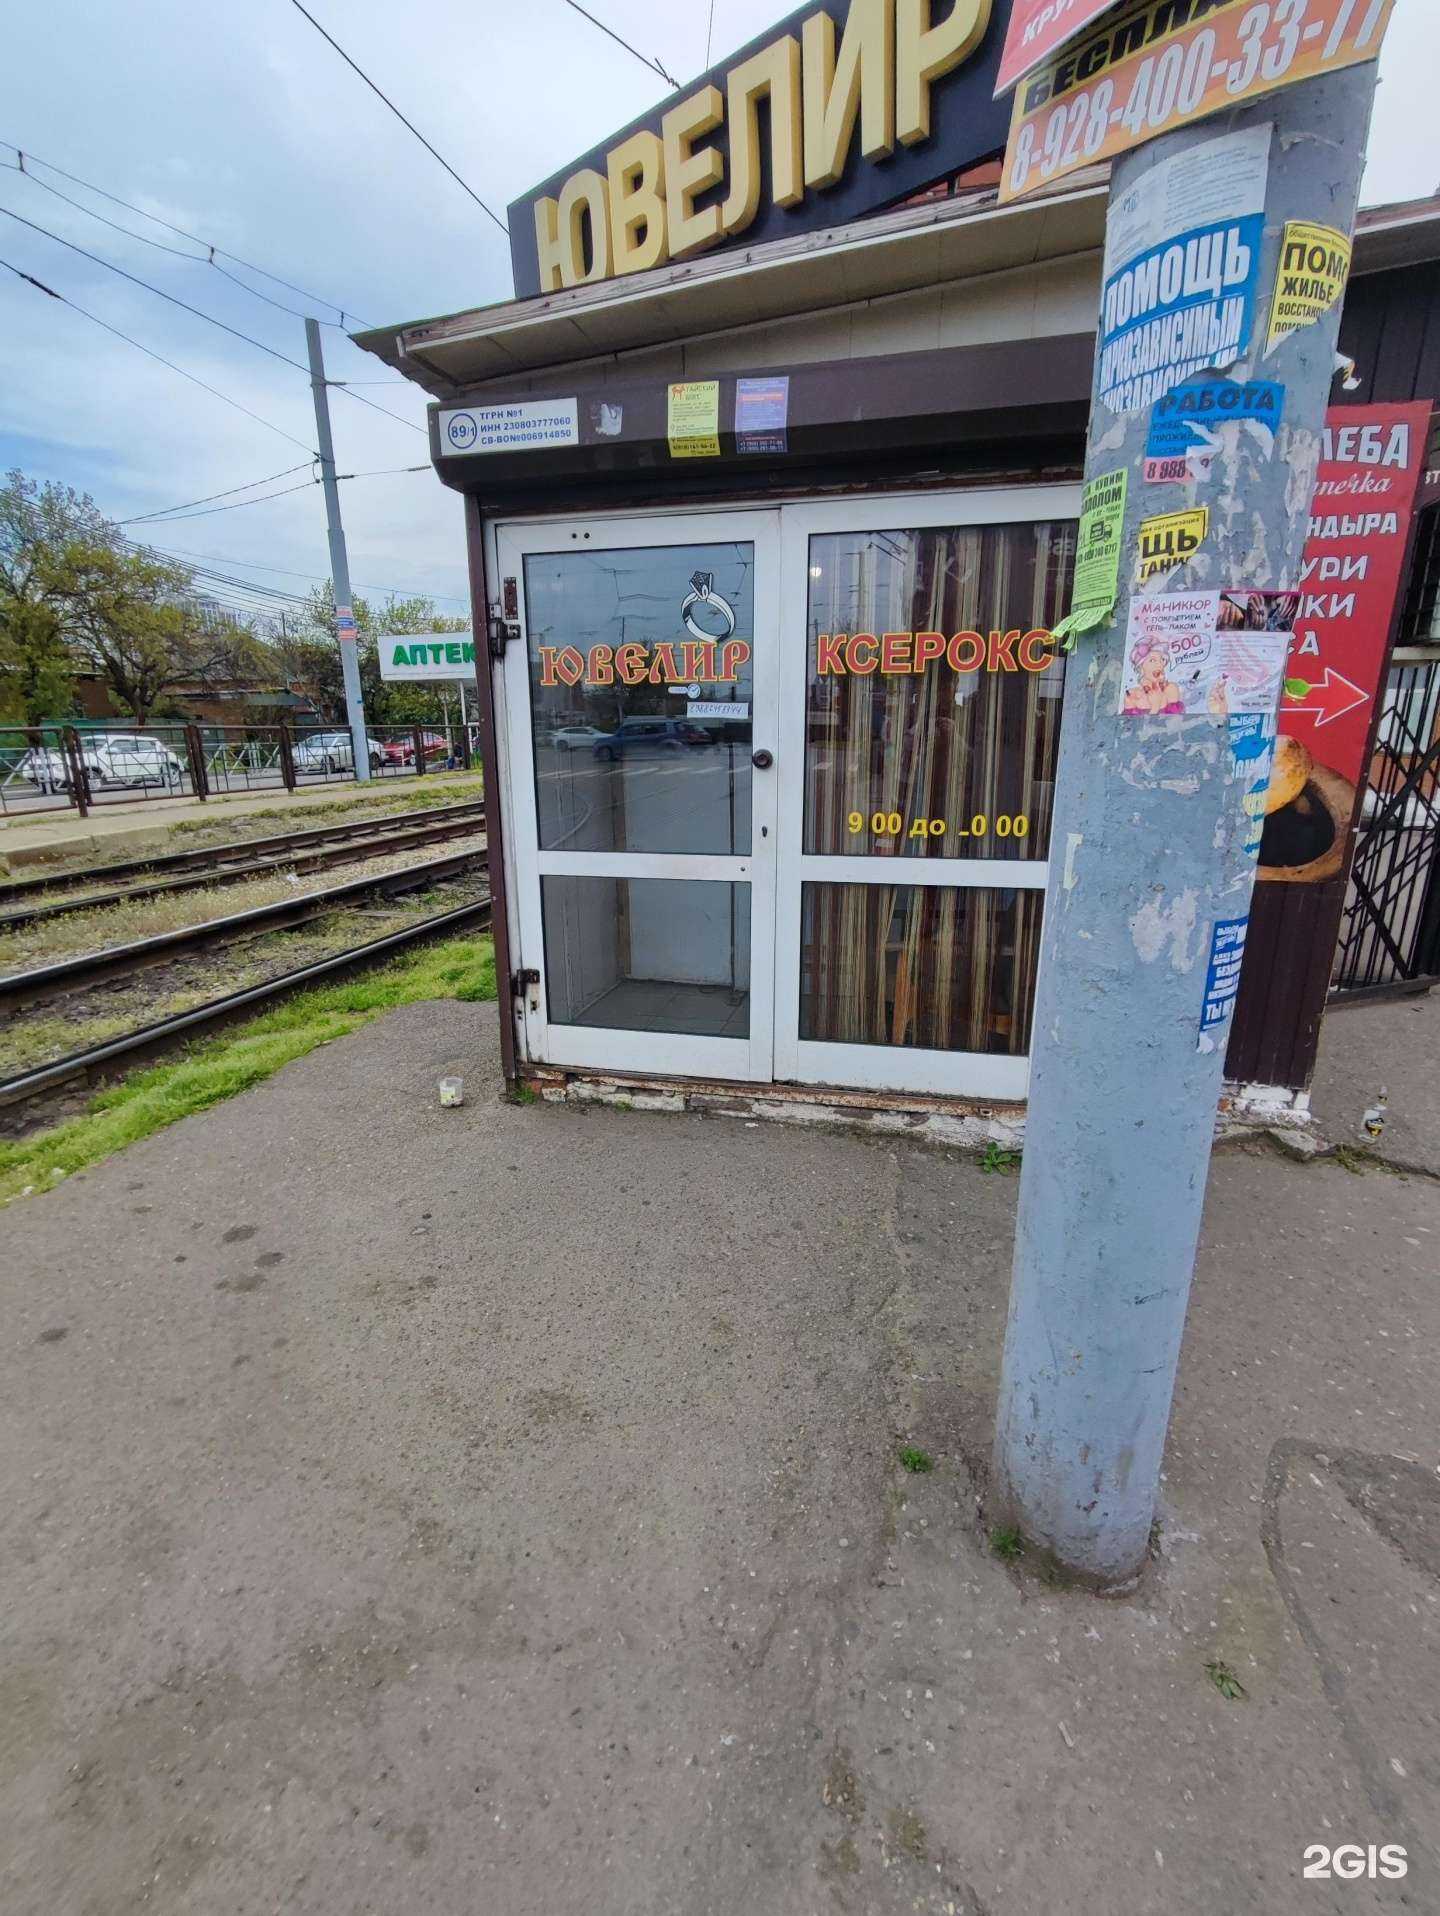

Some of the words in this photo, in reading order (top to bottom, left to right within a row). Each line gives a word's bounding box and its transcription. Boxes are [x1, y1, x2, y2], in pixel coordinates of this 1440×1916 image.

[1021, 0, 1074, 48] КРУ
[534, 0, 992, 293] ЮВЕЛИР
[1105, 227, 1251, 337] ПОМОЩЬ
[1281, 277, 1334, 304] ЖИЛЬЕ
[480, 410, 504, 419] ТГРН
[506, 409, 523, 418] №1
[1158, 386, 1275, 416] РАБОТА
[451, 425, 476, 438] 89/1
[480, 423, 501, 433] ИНН
[1142, 528, 1199, 558] ЩЬ
[1141, 600, 1211, 613] МАНИКЮР
[1151, 614, 1201, 623] ПОКРЫТИЕМ
[392, 642, 476, 666] АПТЕК
[817, 629, 1056, 675] КСЕРОКС
[1171, 634, 1201, 653] 500
[539, 640, 750, 686] ЮВЕЛИР
[848, 812, 863, 833] 9
[871, 813, 902, 834] 00
[909, 818, 946, 838] до
[958, 814, 987, 836] 0
[996, 815, 1029, 837] 00
